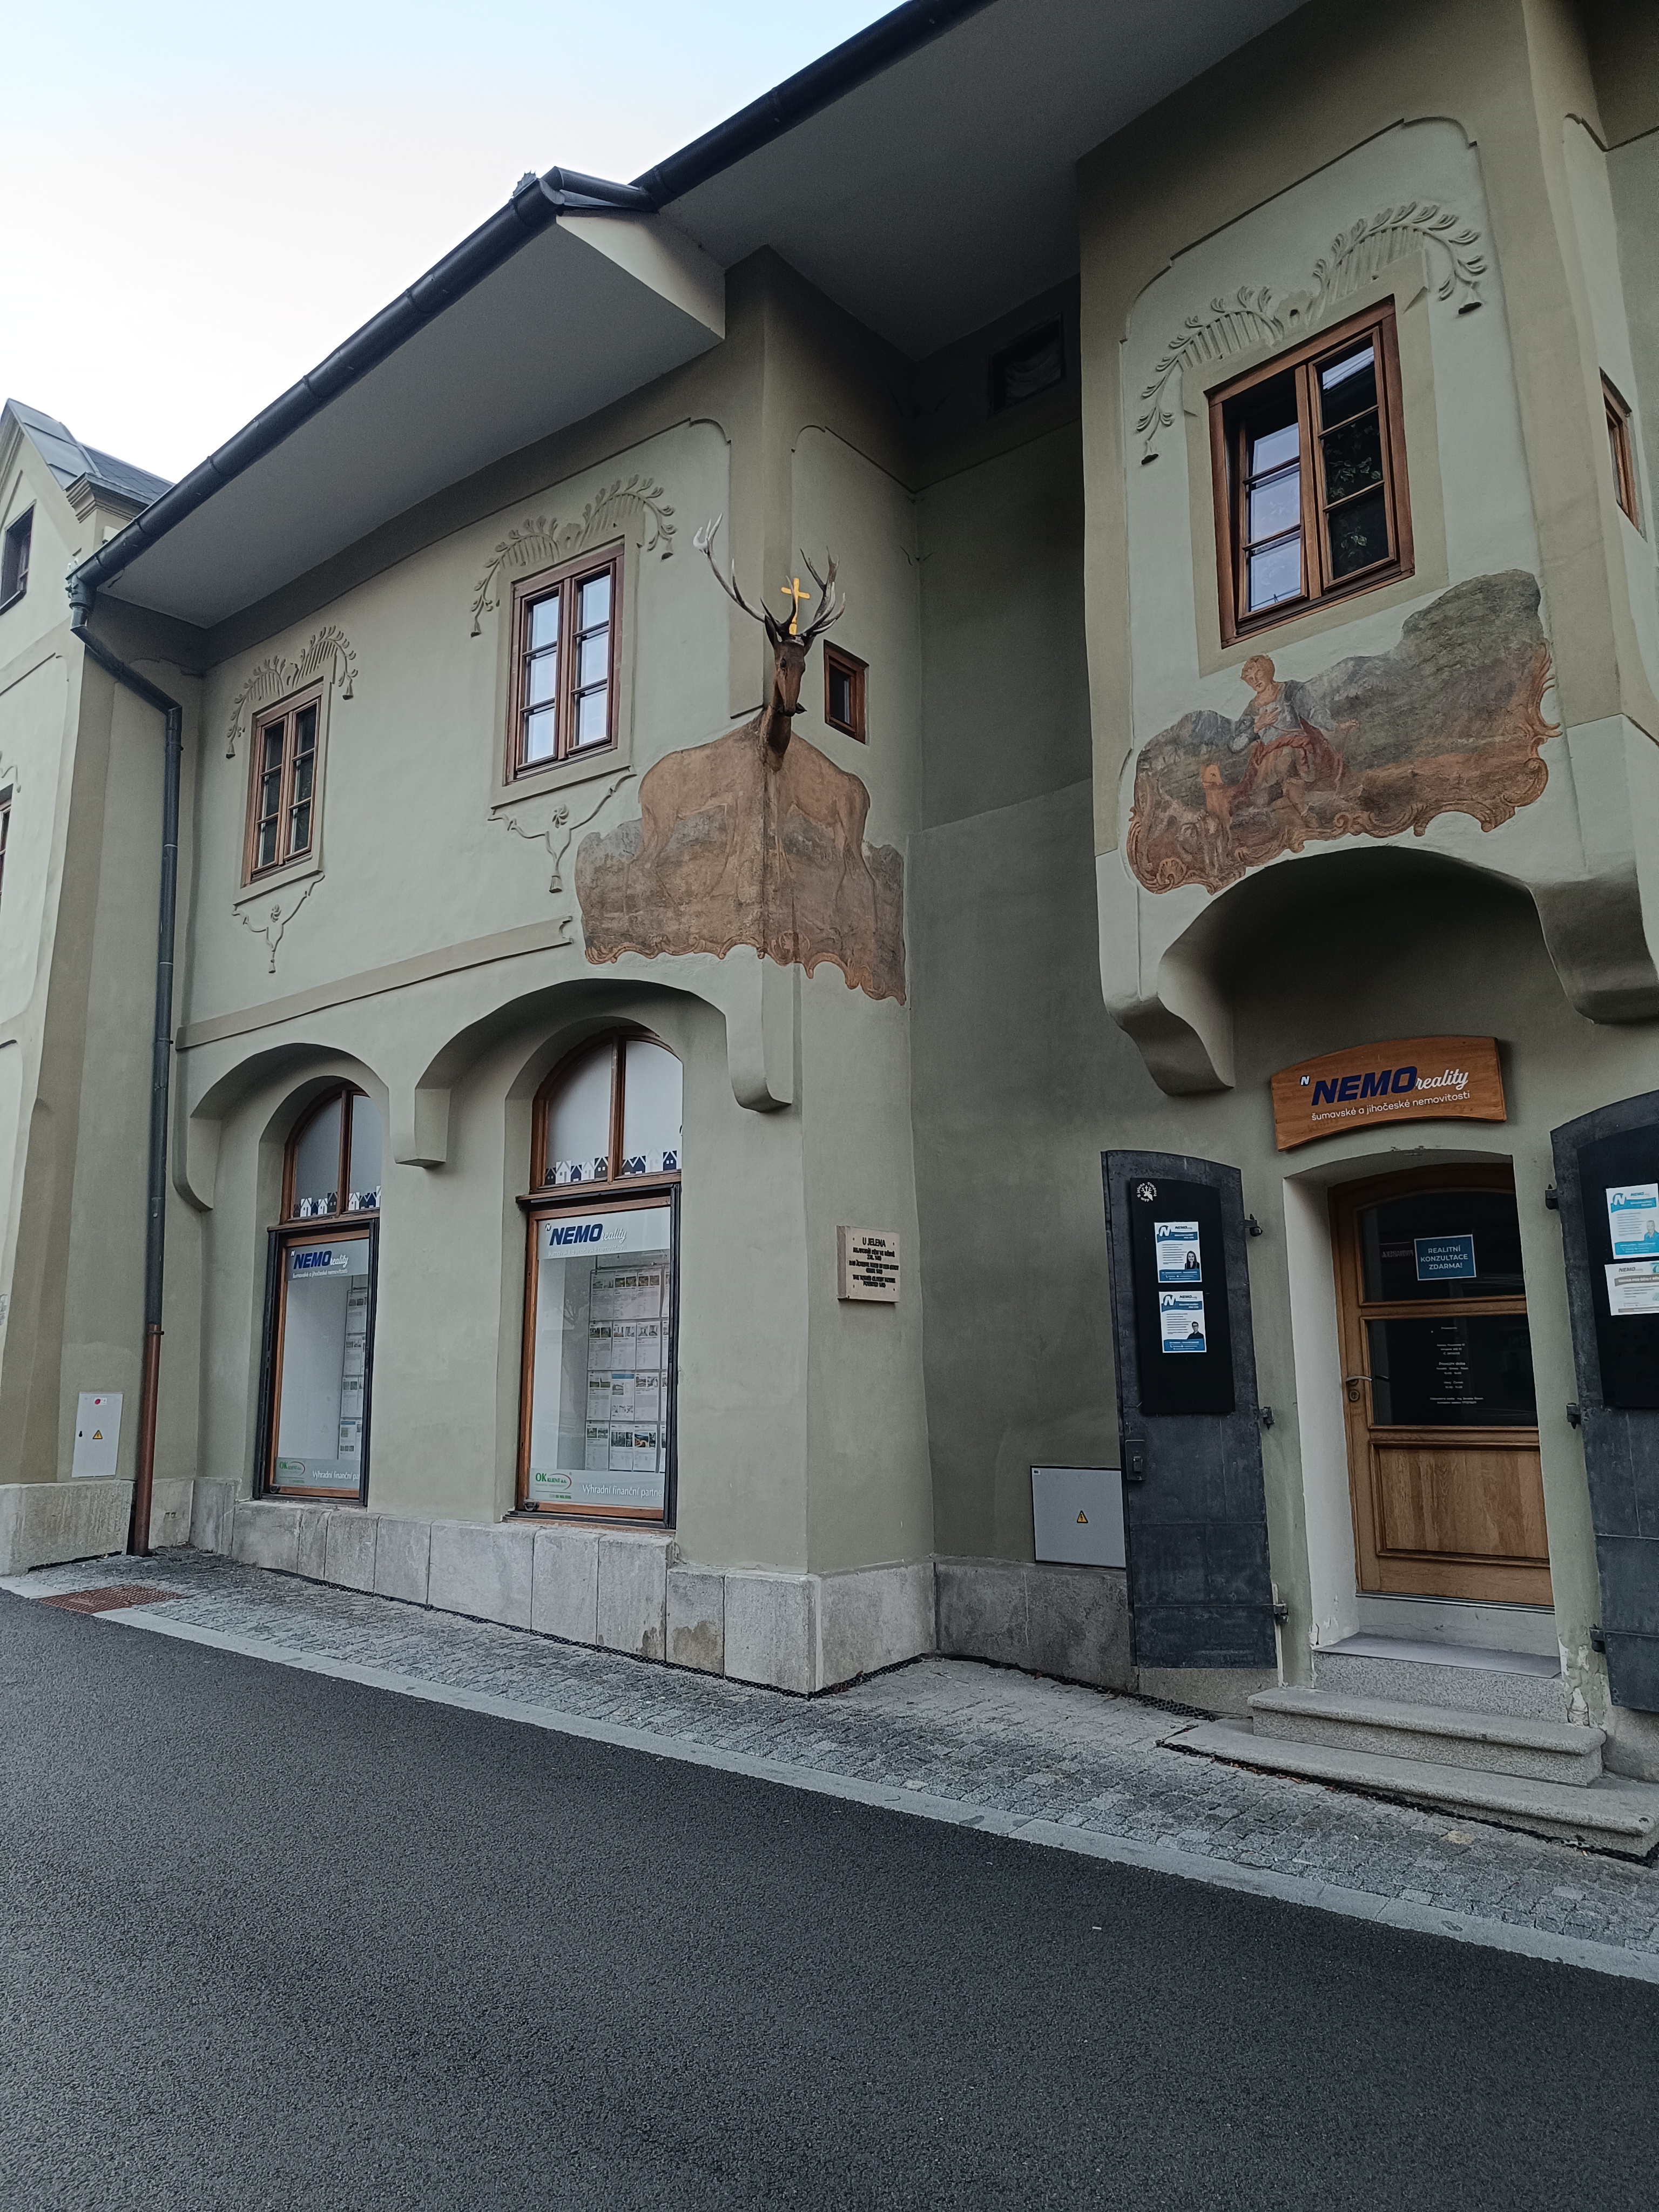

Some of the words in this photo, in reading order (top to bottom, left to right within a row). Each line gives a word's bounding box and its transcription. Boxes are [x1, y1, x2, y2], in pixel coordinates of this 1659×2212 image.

[1311, 1065, 1418, 1106] NEMO
[1415, 1069, 1469, 1090] reality
[1311, 1106, 1357, 1121] šumavské
[1358, 1106, 1365, 1115] a
[1366, 1099, 1411, 1116] jihočeské
[1413, 1090, 1471, 1107] nemovitosti
[549, 1223, 603, 1246] NEMO
[601, 1228, 626, 1243] reality
[862, 1237, 867, 1245] U
[867, 1238, 886, 1247] JELENA
[1428, 1244, 1461, 1254] REALITNÍ
[293, 1250, 332, 1270] NEMO
[330, 1255, 349, 1268] reality
[1420, 1254, 1469, 1263] KONZULTACE
[312, 1470, 333, 1481] Výhradní
[333, 1471, 353, 1480] finanční
[535, 1472, 547, 1482] OK
[582, 1483, 612, 1495] Výhradní
[613, 1485, 640, 1496] finanční
